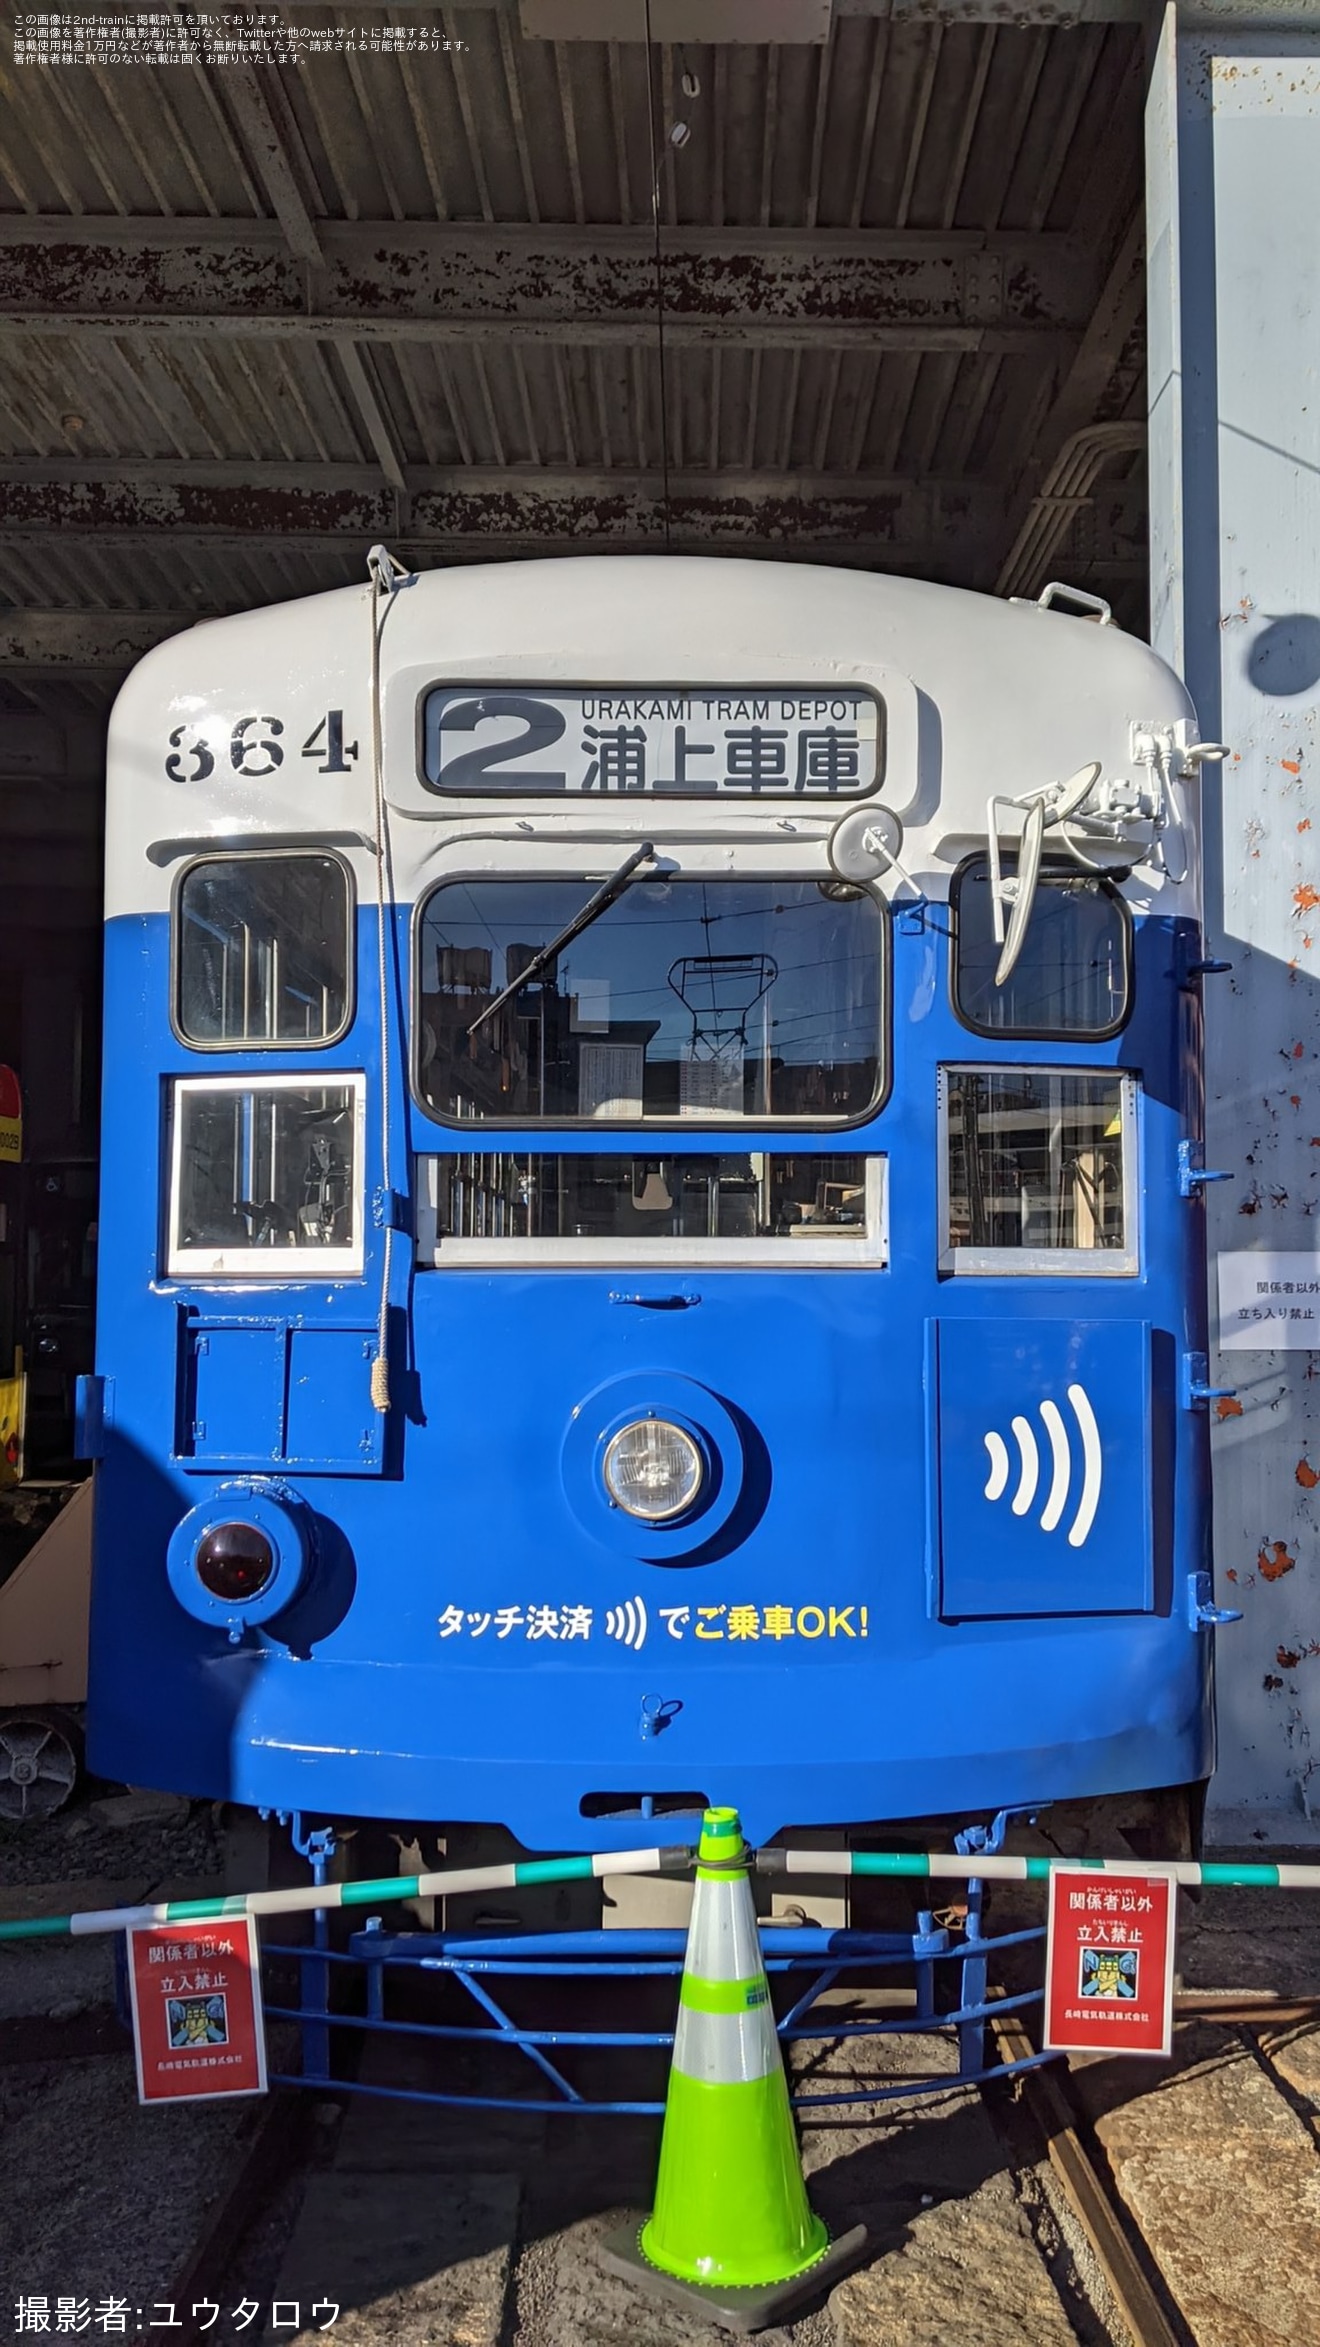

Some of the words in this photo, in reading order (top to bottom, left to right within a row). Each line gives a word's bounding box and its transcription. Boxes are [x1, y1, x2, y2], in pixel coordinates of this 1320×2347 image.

[581, 700, 693, 721] URAKAMI
[704, 700, 775, 721] TRAM
[781, 700, 862, 721] DEPOT
[165, 709, 359, 783] 364
[438, 697, 567, 788] 2
[582, 725, 861, 793] 浦上車庫
[1256, 1281, 1320, 1294] 関係者以外
[1238, 1307, 1315, 1320] 立ち入り禁止
[438, 1604, 593, 1640] タッチ決済
[658, 1604, 869, 1640] でご乗車OK!
[1069, 1892, 1153, 1913] 関係者以外
[1076, 1925, 1144, 1943] 立入禁止
[148, 1938, 234, 1964] 関係者以外
[160, 1971, 229, 1993] 立入禁止
